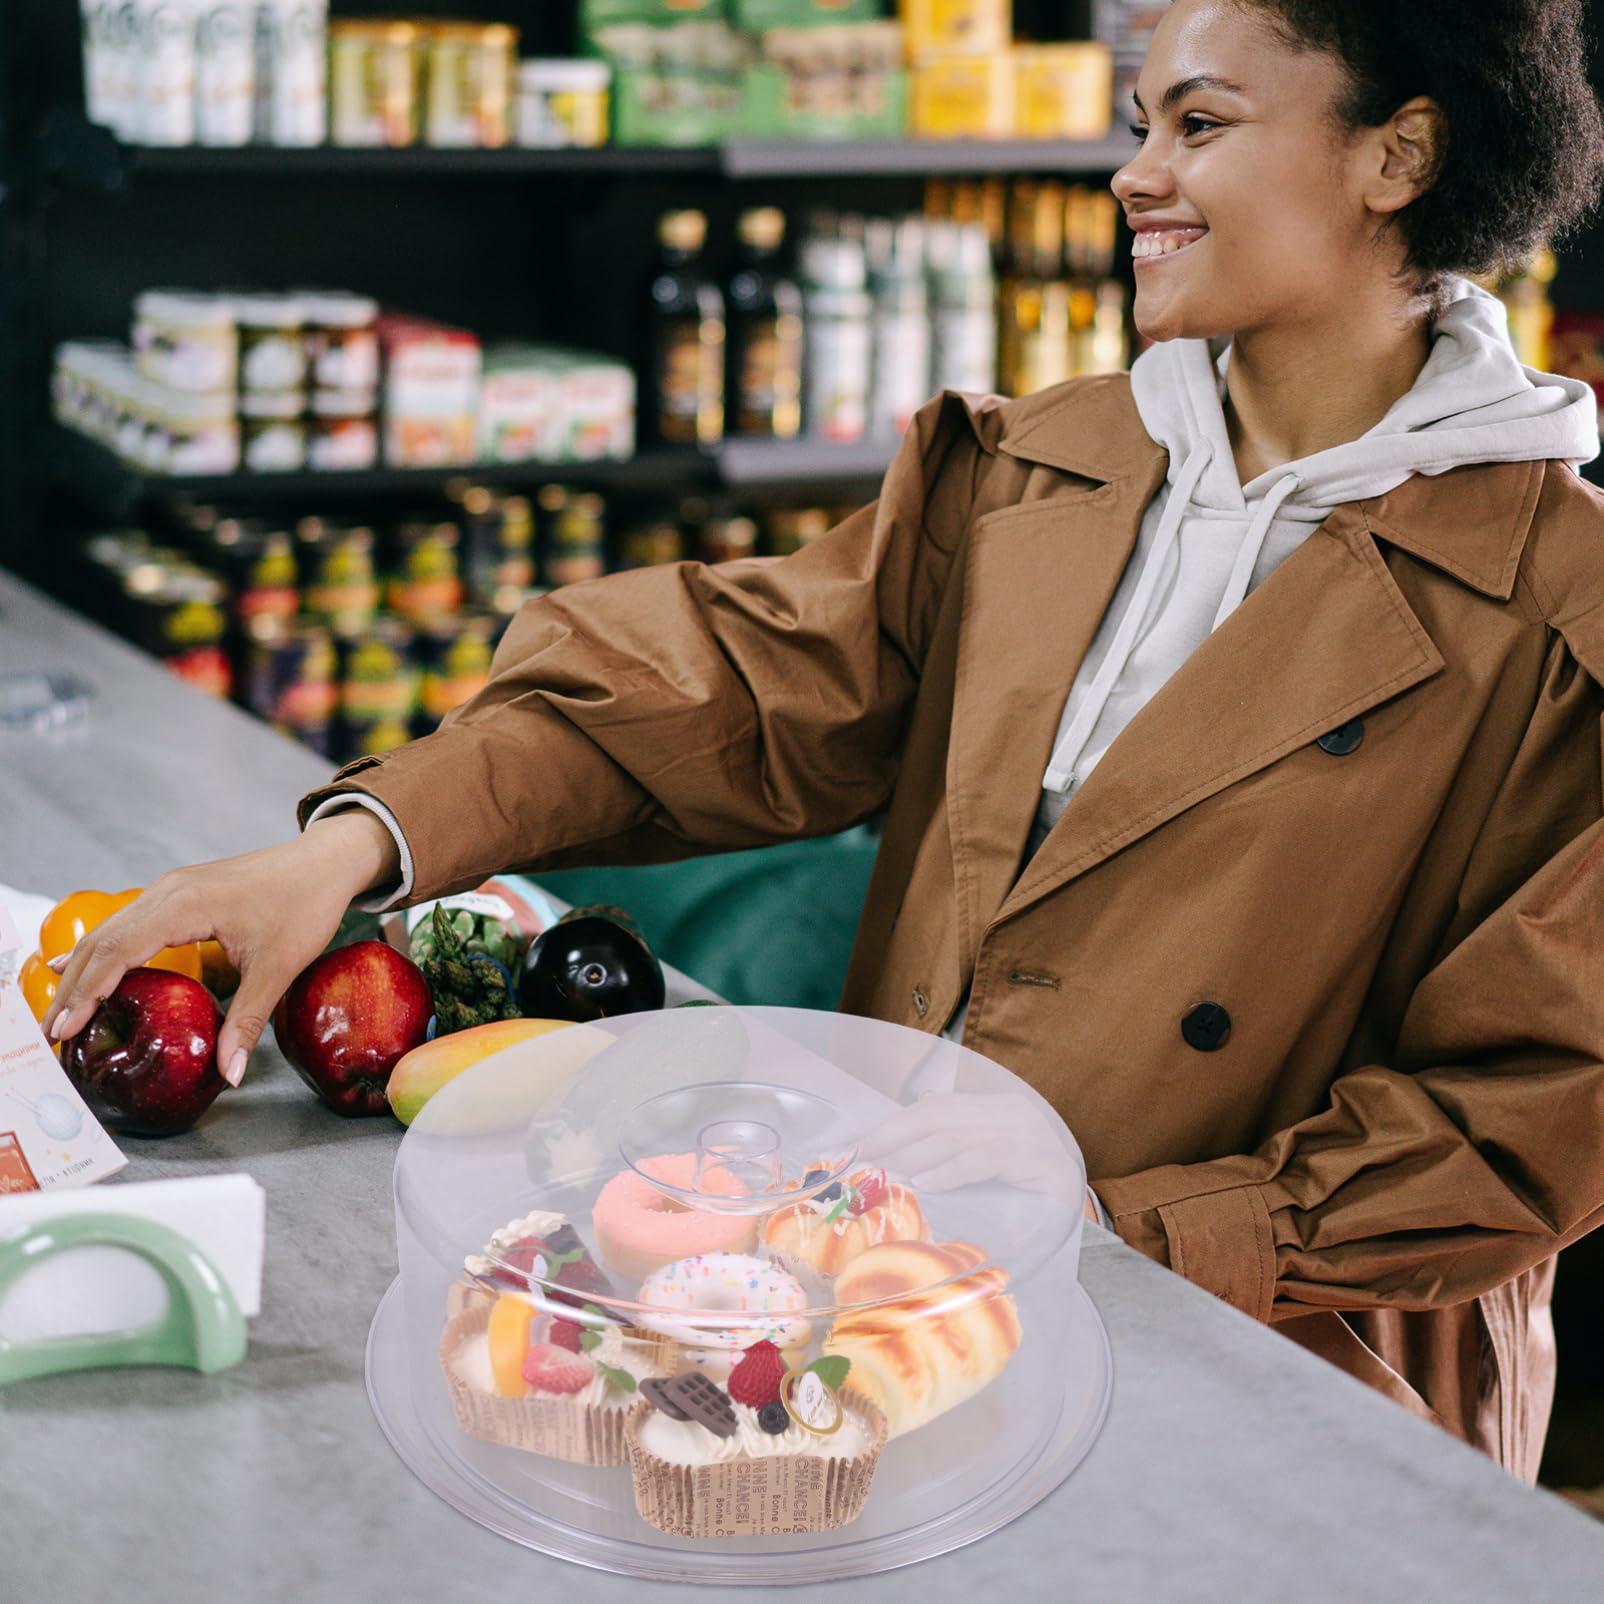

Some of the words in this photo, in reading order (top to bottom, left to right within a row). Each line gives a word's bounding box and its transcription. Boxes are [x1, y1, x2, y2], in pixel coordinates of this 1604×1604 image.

[716, 1498, 725, 1525] Bonne
[736, 1463, 751, 1524] CHANCE!
[772, 1494, 781, 1521] Bonne
[794, 1458, 809, 1521] CHANCE!
